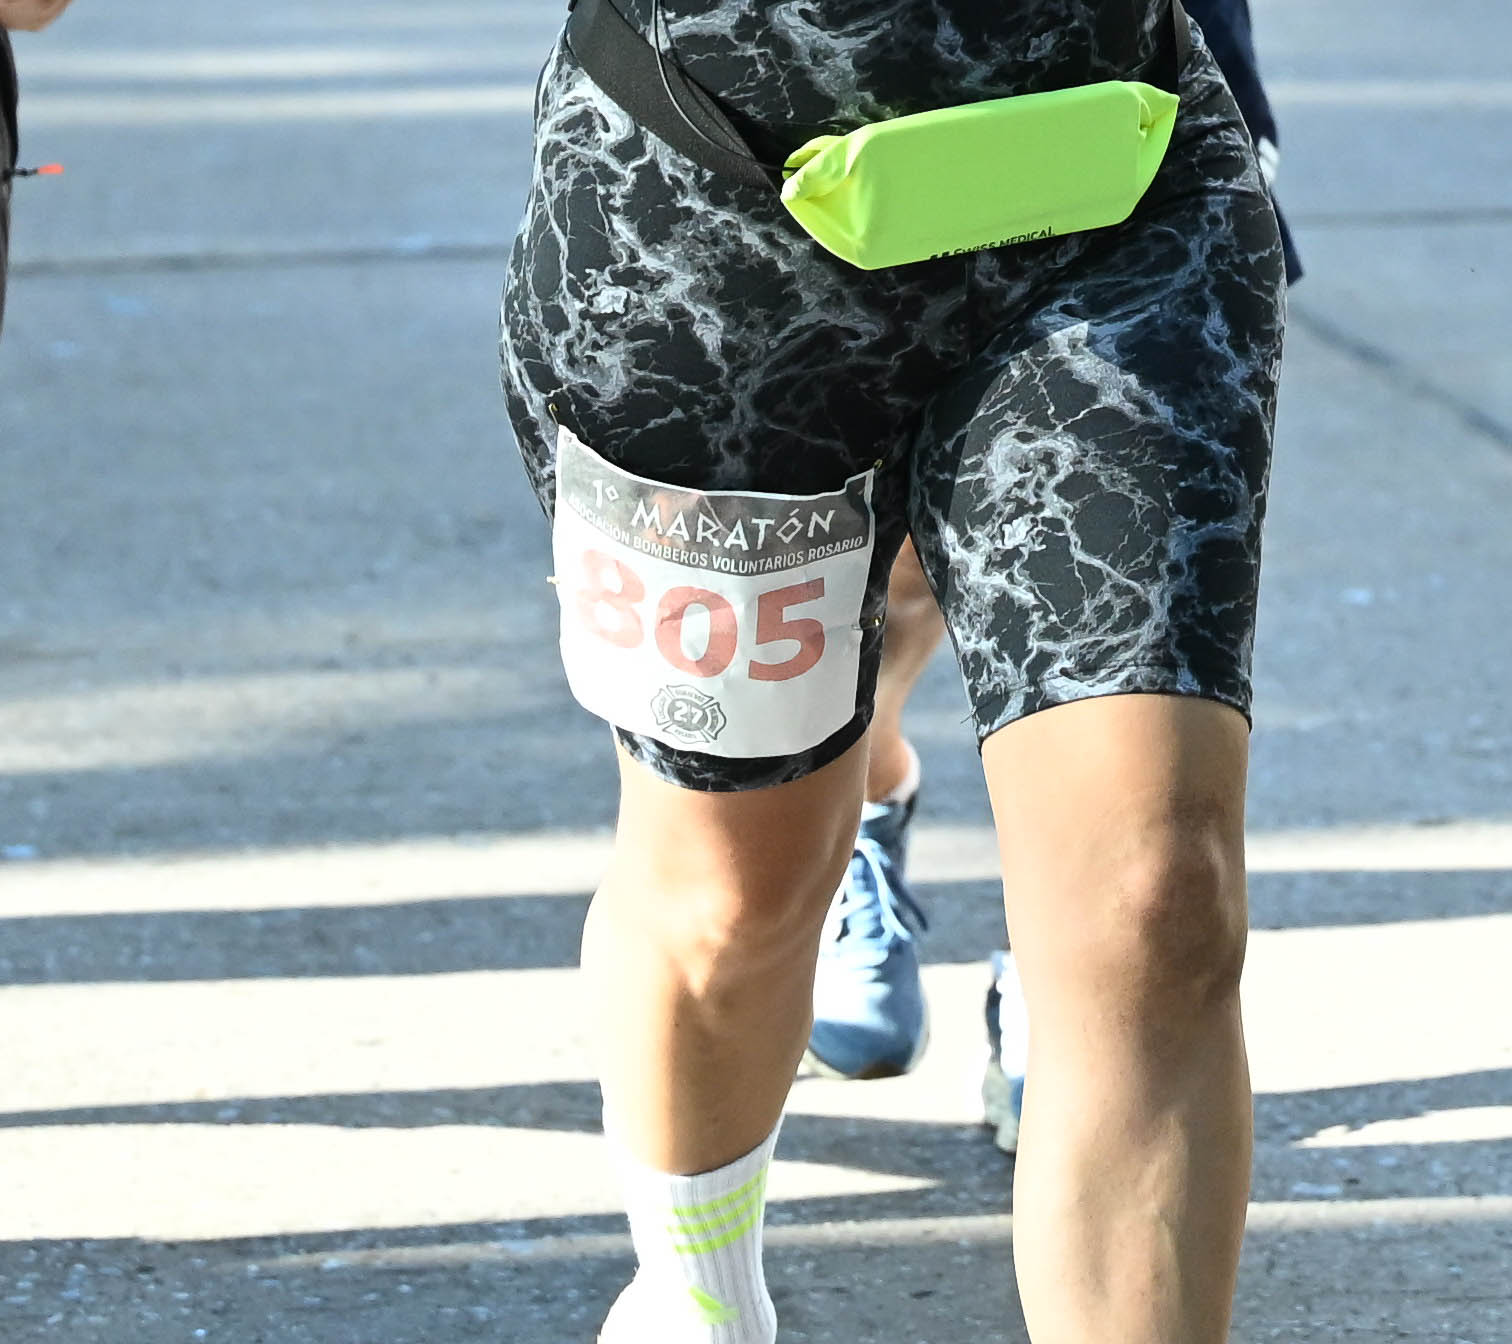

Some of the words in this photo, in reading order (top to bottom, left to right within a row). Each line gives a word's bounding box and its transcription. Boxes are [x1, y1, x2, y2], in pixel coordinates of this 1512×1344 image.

[631, 498, 836, 552] MARATÓN
[633, 534, 708, 569] BOMBEROS
[712, 549, 805, 576] VOLUNTARIOS
[807, 534, 864, 562] ROSARIO
[576, 549, 826, 682] 805
